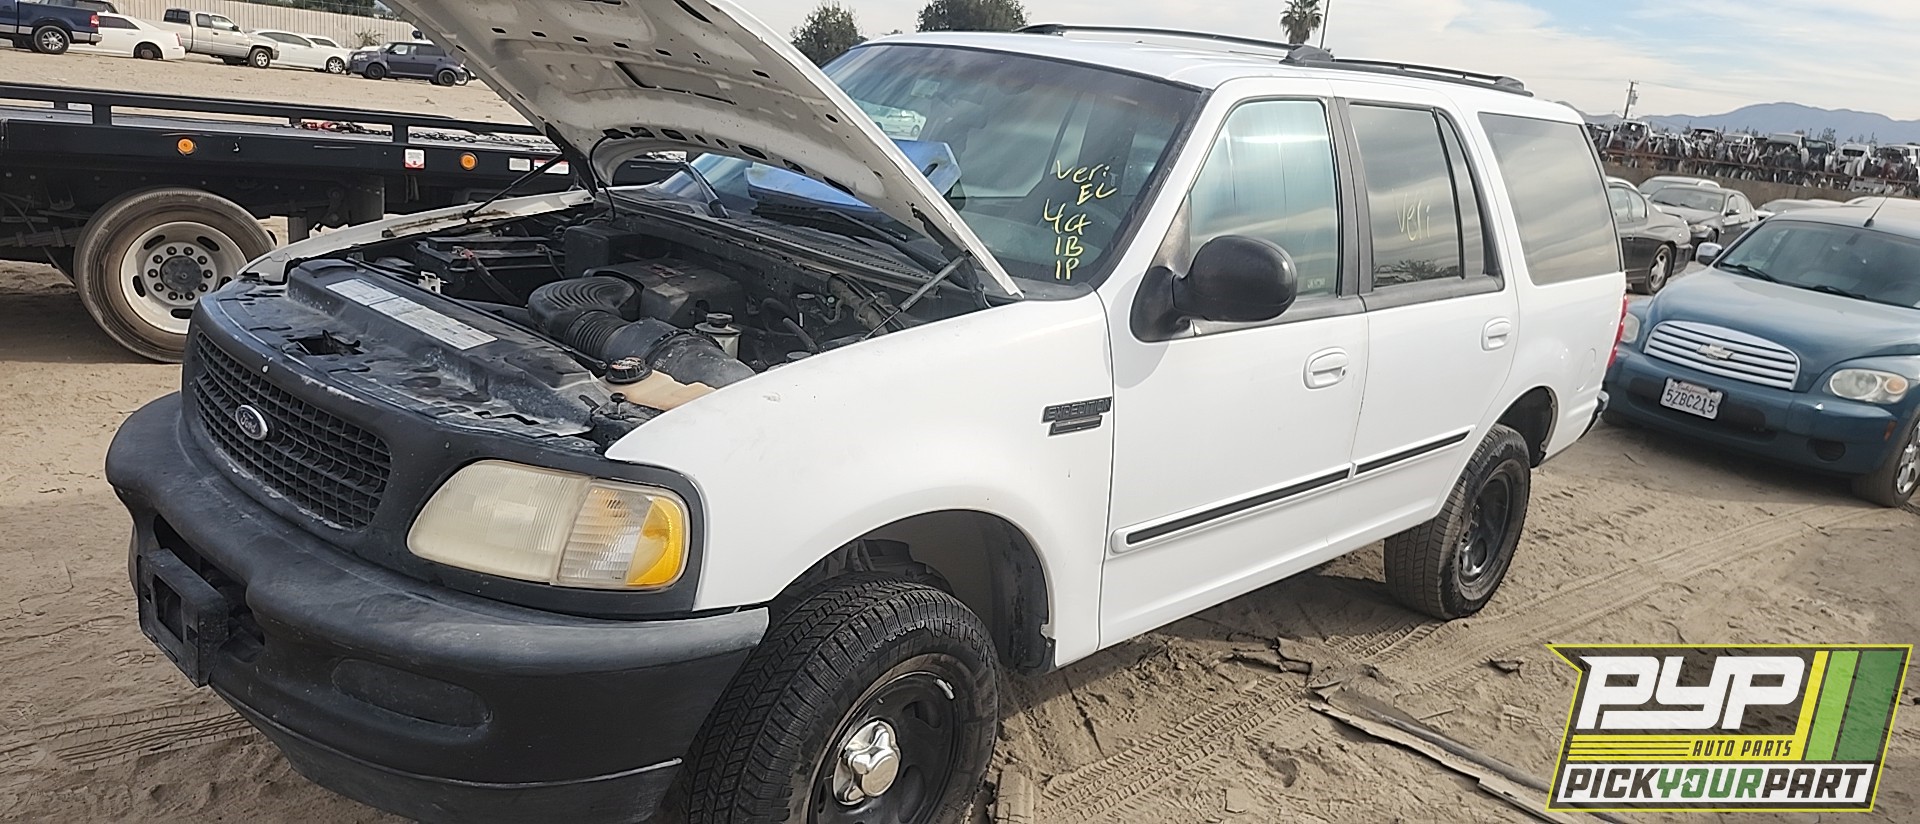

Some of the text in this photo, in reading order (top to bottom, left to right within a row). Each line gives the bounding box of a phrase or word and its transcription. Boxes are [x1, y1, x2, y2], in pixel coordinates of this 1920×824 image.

[1045, 398, 1112, 420] EXPEDITION
[1665, 389, 1716, 413] 5ZBC215
[239, 411, 258, 434] Ford
